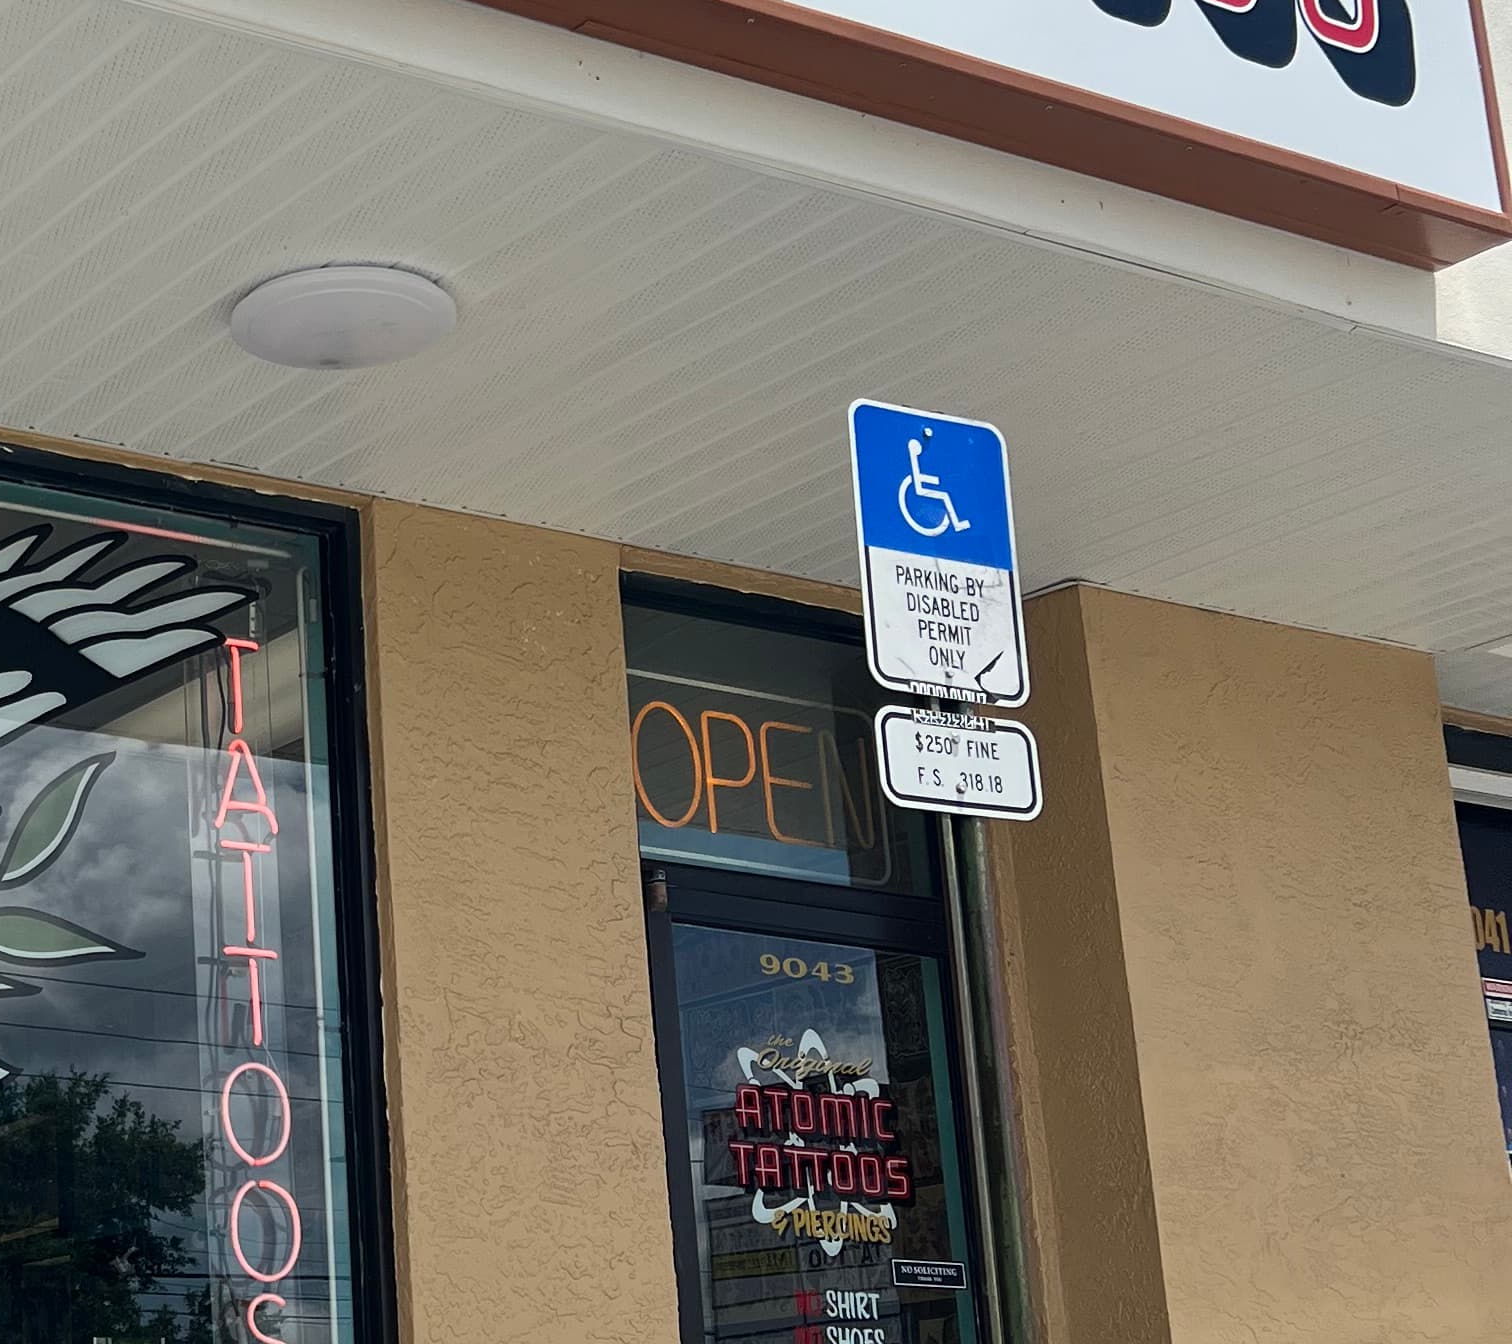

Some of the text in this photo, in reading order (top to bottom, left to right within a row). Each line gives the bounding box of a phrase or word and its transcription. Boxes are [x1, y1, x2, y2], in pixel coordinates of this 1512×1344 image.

[895, 564, 984, 598] PARKING BY
[906, 591, 980, 622] DISABLED
[918, 618, 972, 646] PERMIT
[929, 645, 966, 670] ONLY
[915, 731, 1001, 761] $250 FINE
[759, 953, 855, 984] 9043
[757, 1047, 873, 1080] Original
[735, 1084, 897, 1141] ATOMIC
[728, 1138, 912, 1200] TATTOOS
[792, 1208, 893, 1244] PIERCINGS
[901, 1265, 958, 1277] NO SOLICITING
[795, 1288, 881, 1321] NO SHIRT
